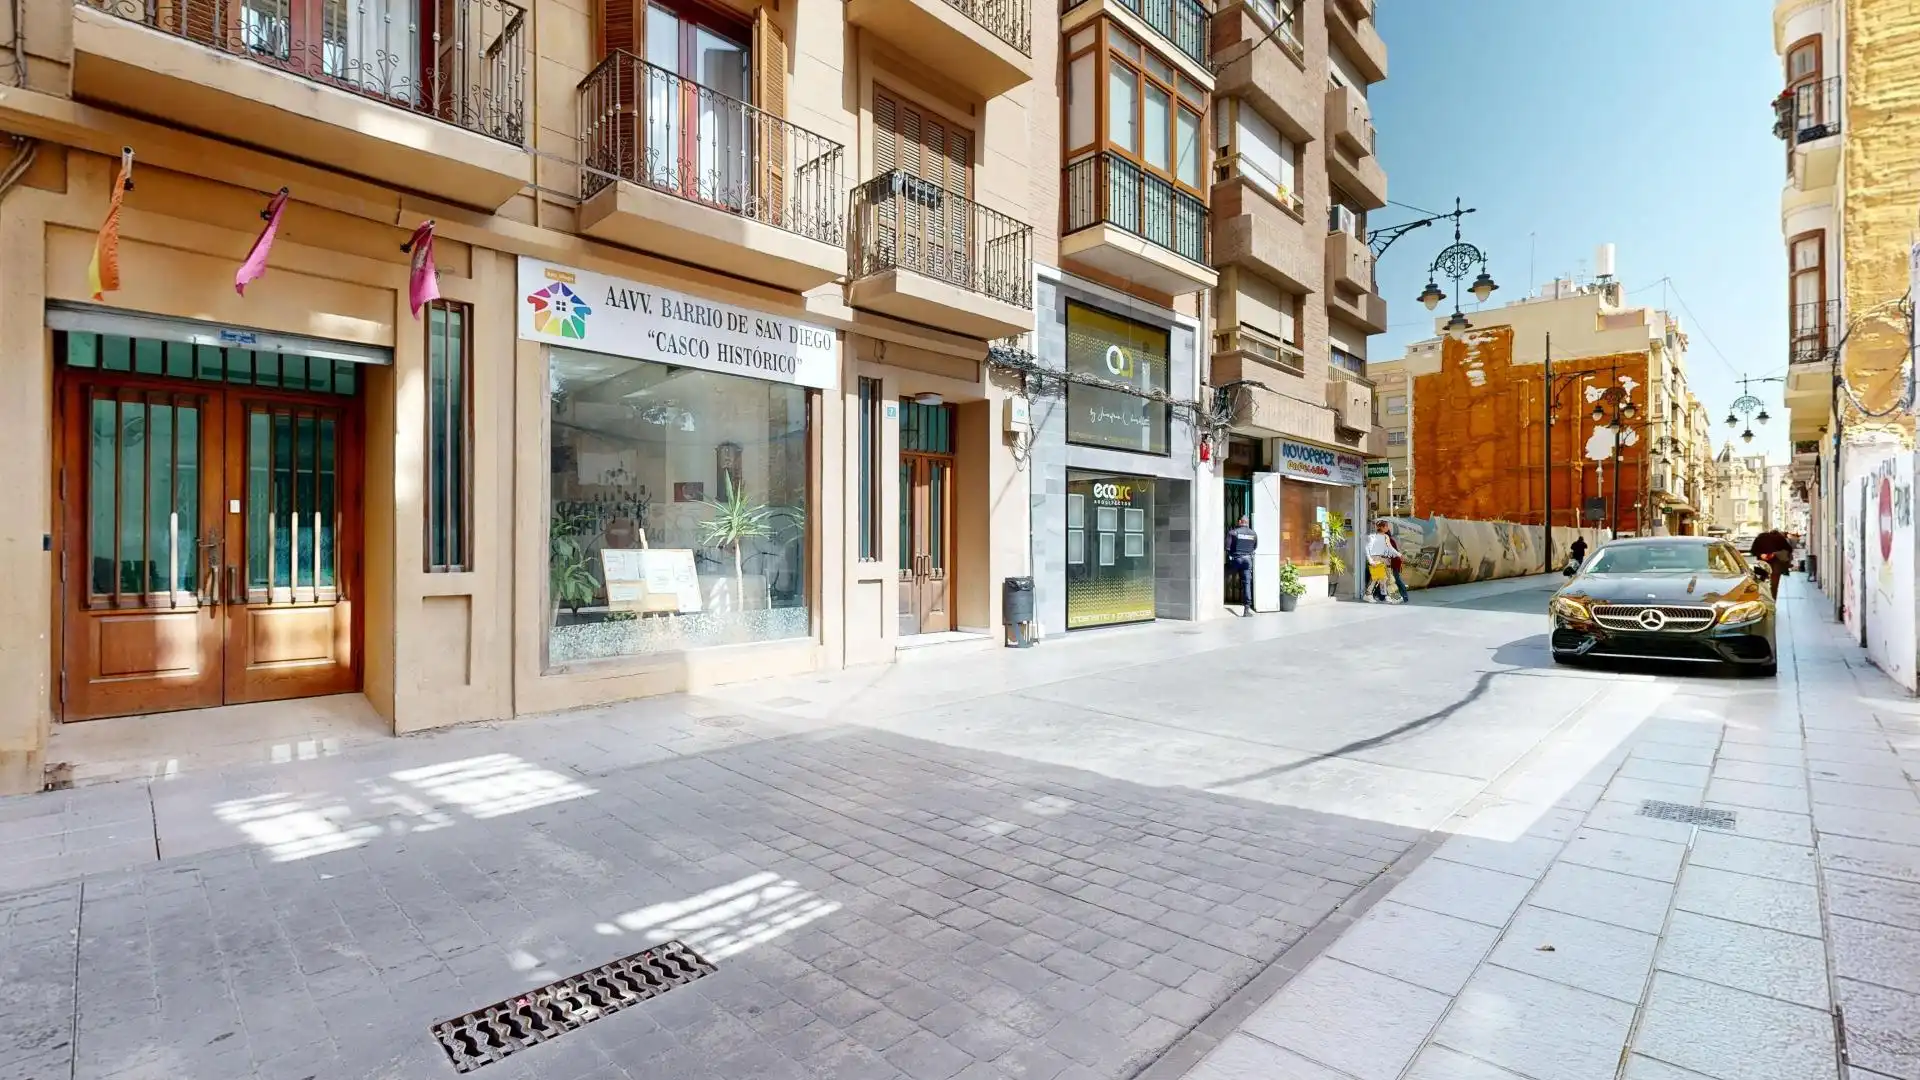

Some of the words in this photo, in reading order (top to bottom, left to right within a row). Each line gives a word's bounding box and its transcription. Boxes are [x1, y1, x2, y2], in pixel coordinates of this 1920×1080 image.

[605, 285, 652, 315] AAVV.
[660, 297, 723, 329] BARRIO
[727, 312, 748, 334] DE
[755, 318, 782, 341] SAN
[788, 325, 831, 351] DIEGO
